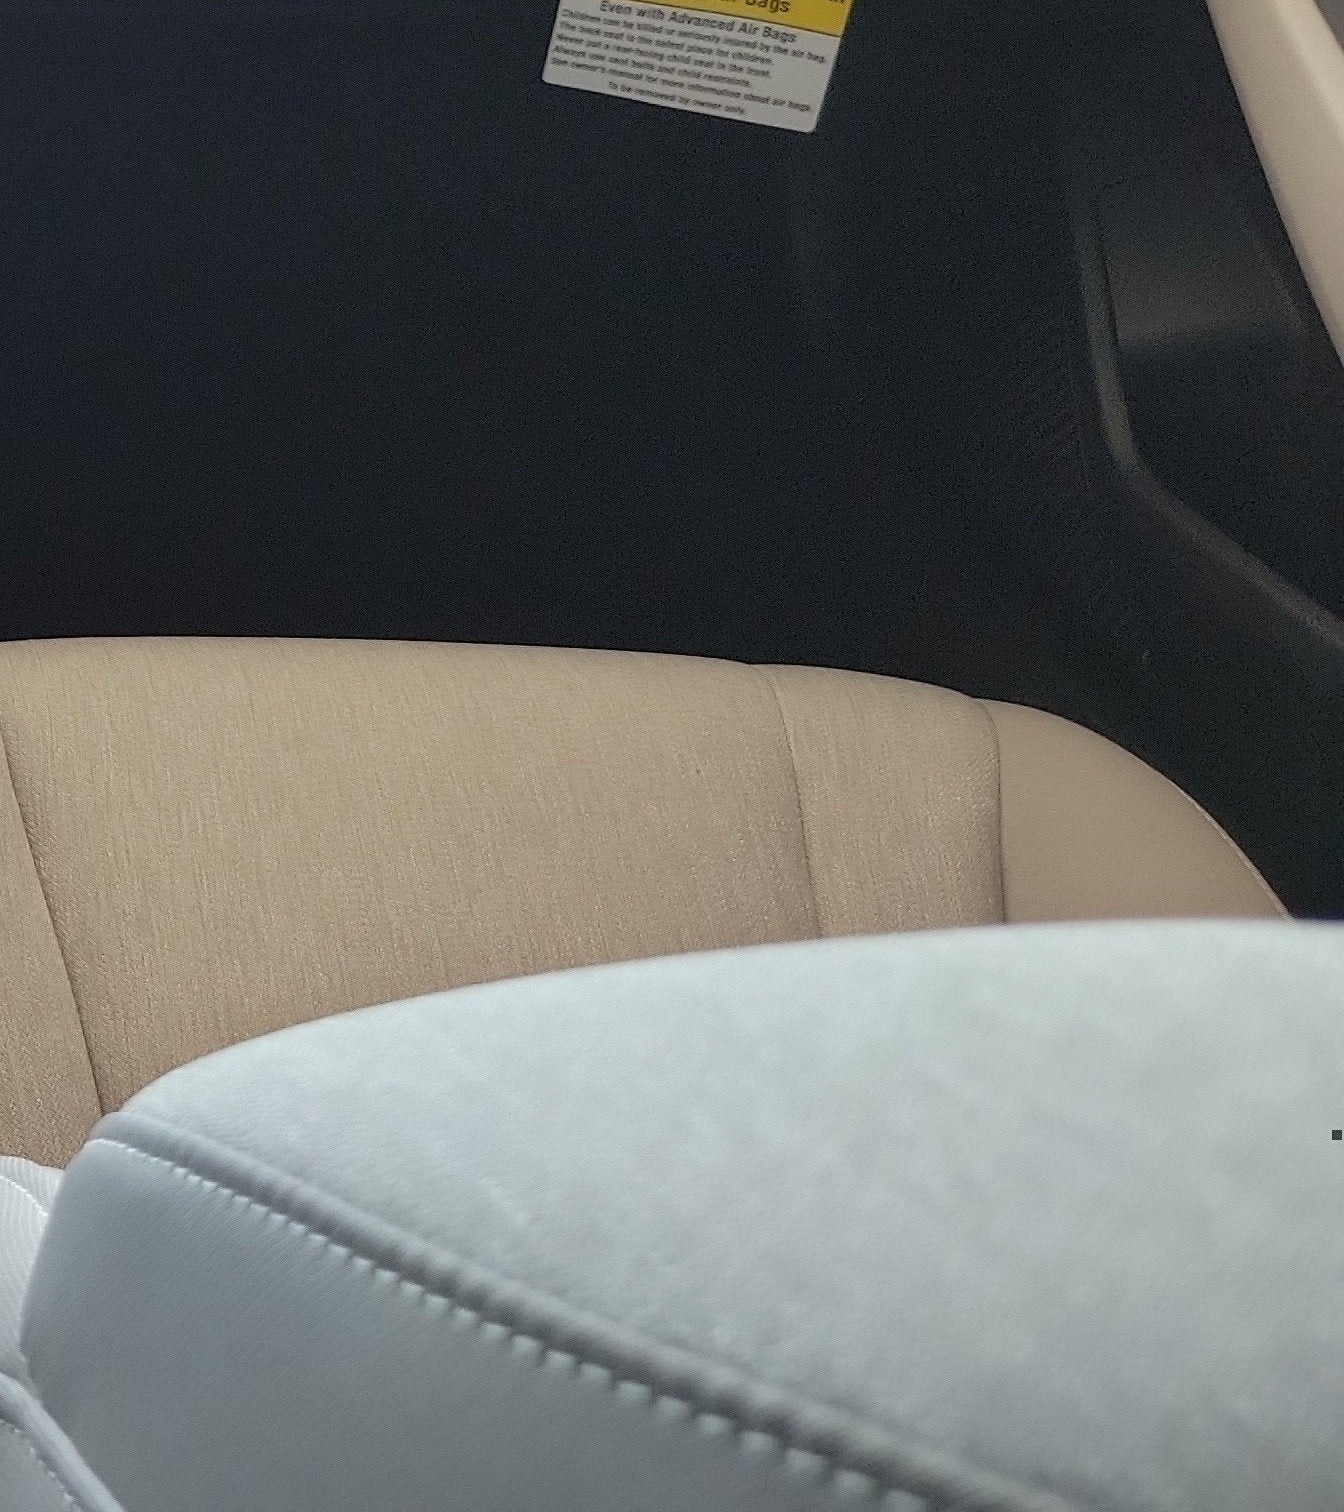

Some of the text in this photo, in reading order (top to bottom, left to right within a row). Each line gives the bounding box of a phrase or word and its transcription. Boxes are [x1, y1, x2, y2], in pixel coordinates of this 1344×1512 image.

[600, 0, 797, 43] Even with Advanced Air Bags
